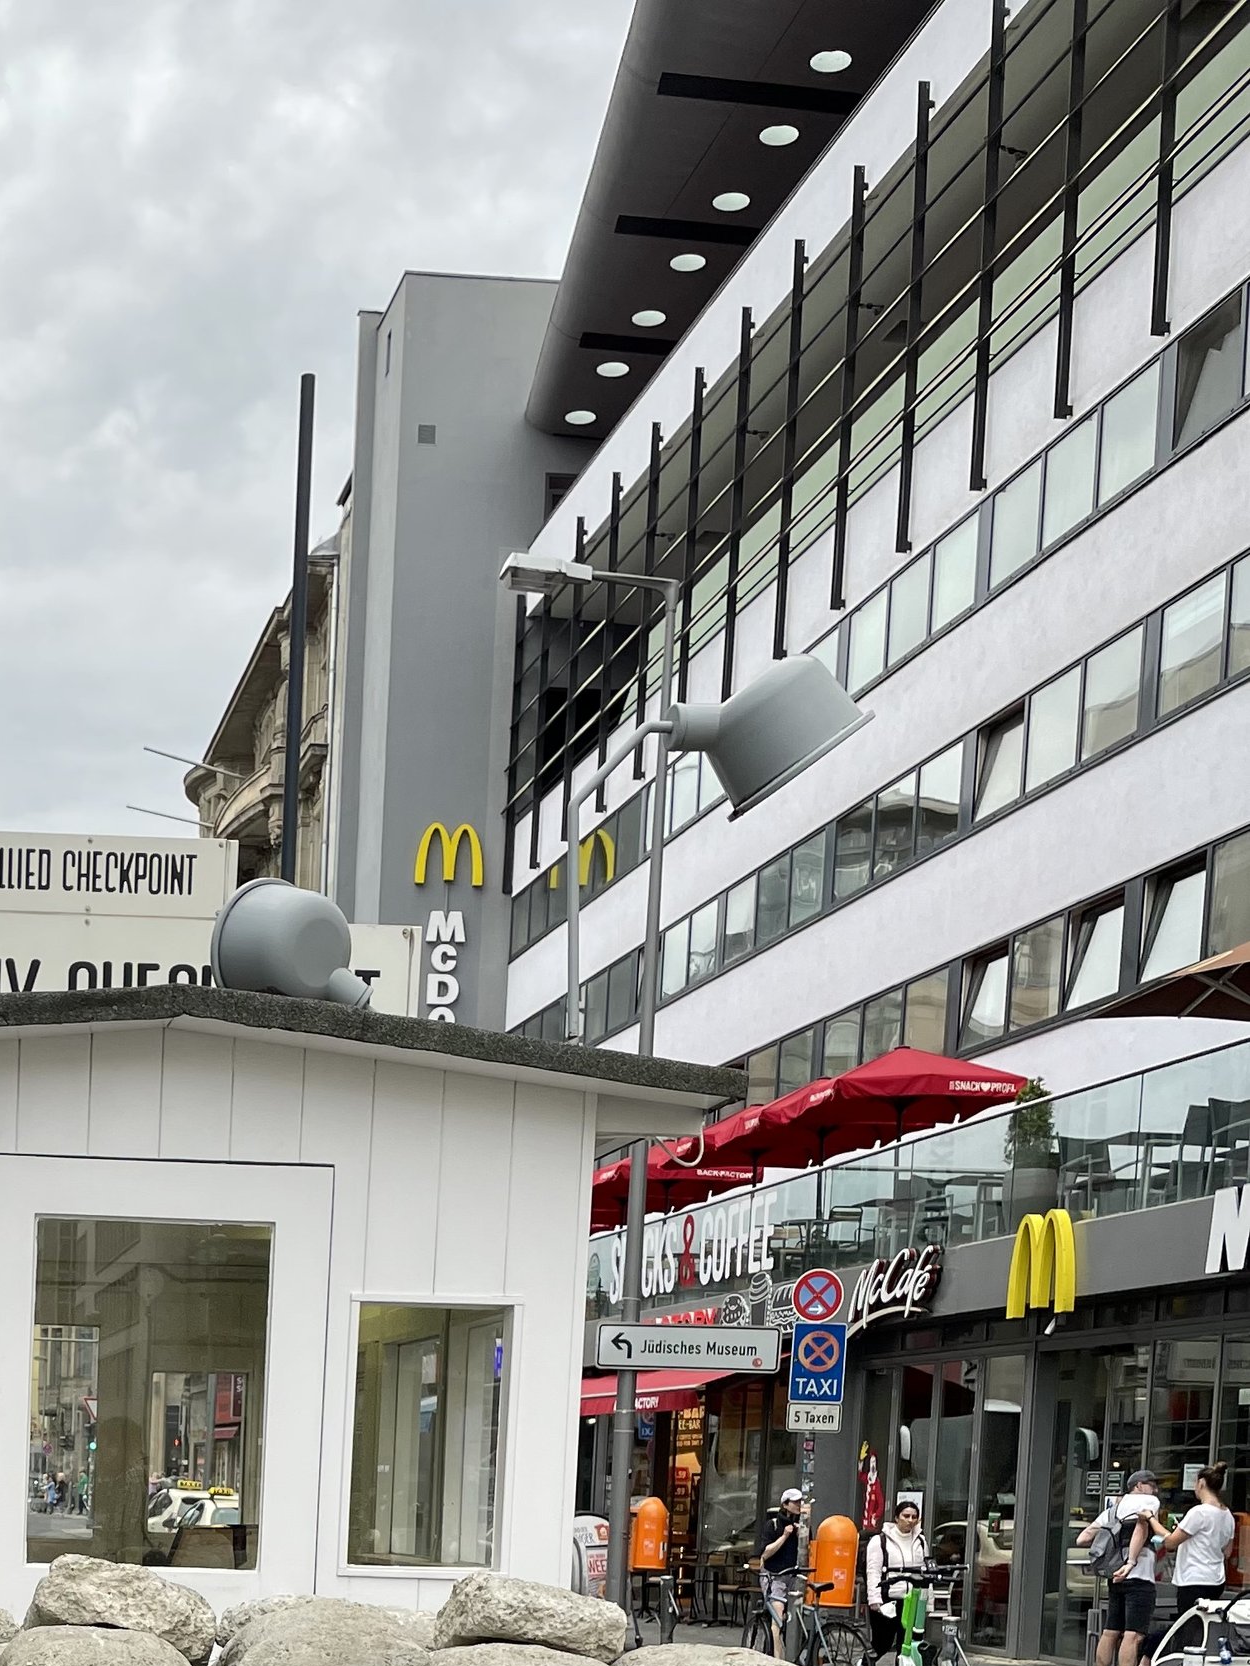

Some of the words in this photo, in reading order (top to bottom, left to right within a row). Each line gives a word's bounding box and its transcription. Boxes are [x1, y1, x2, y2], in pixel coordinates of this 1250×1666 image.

[62, 849, 199, 896] CHECKPOINT
[610, 1222, 678, 1305] SCKS
[699, 1191, 778, 1286] COFFEE
[847, 1245, 936, 1330] McCafé
[640, 1338, 702, 1356] Jüdisches
[706, 1341, 758, 1357] Museum
[795, 1377, 838, 1396] TAXI
[794, 1410, 801, 1423] 5
[804, 1411, 835, 1424] Taxen
